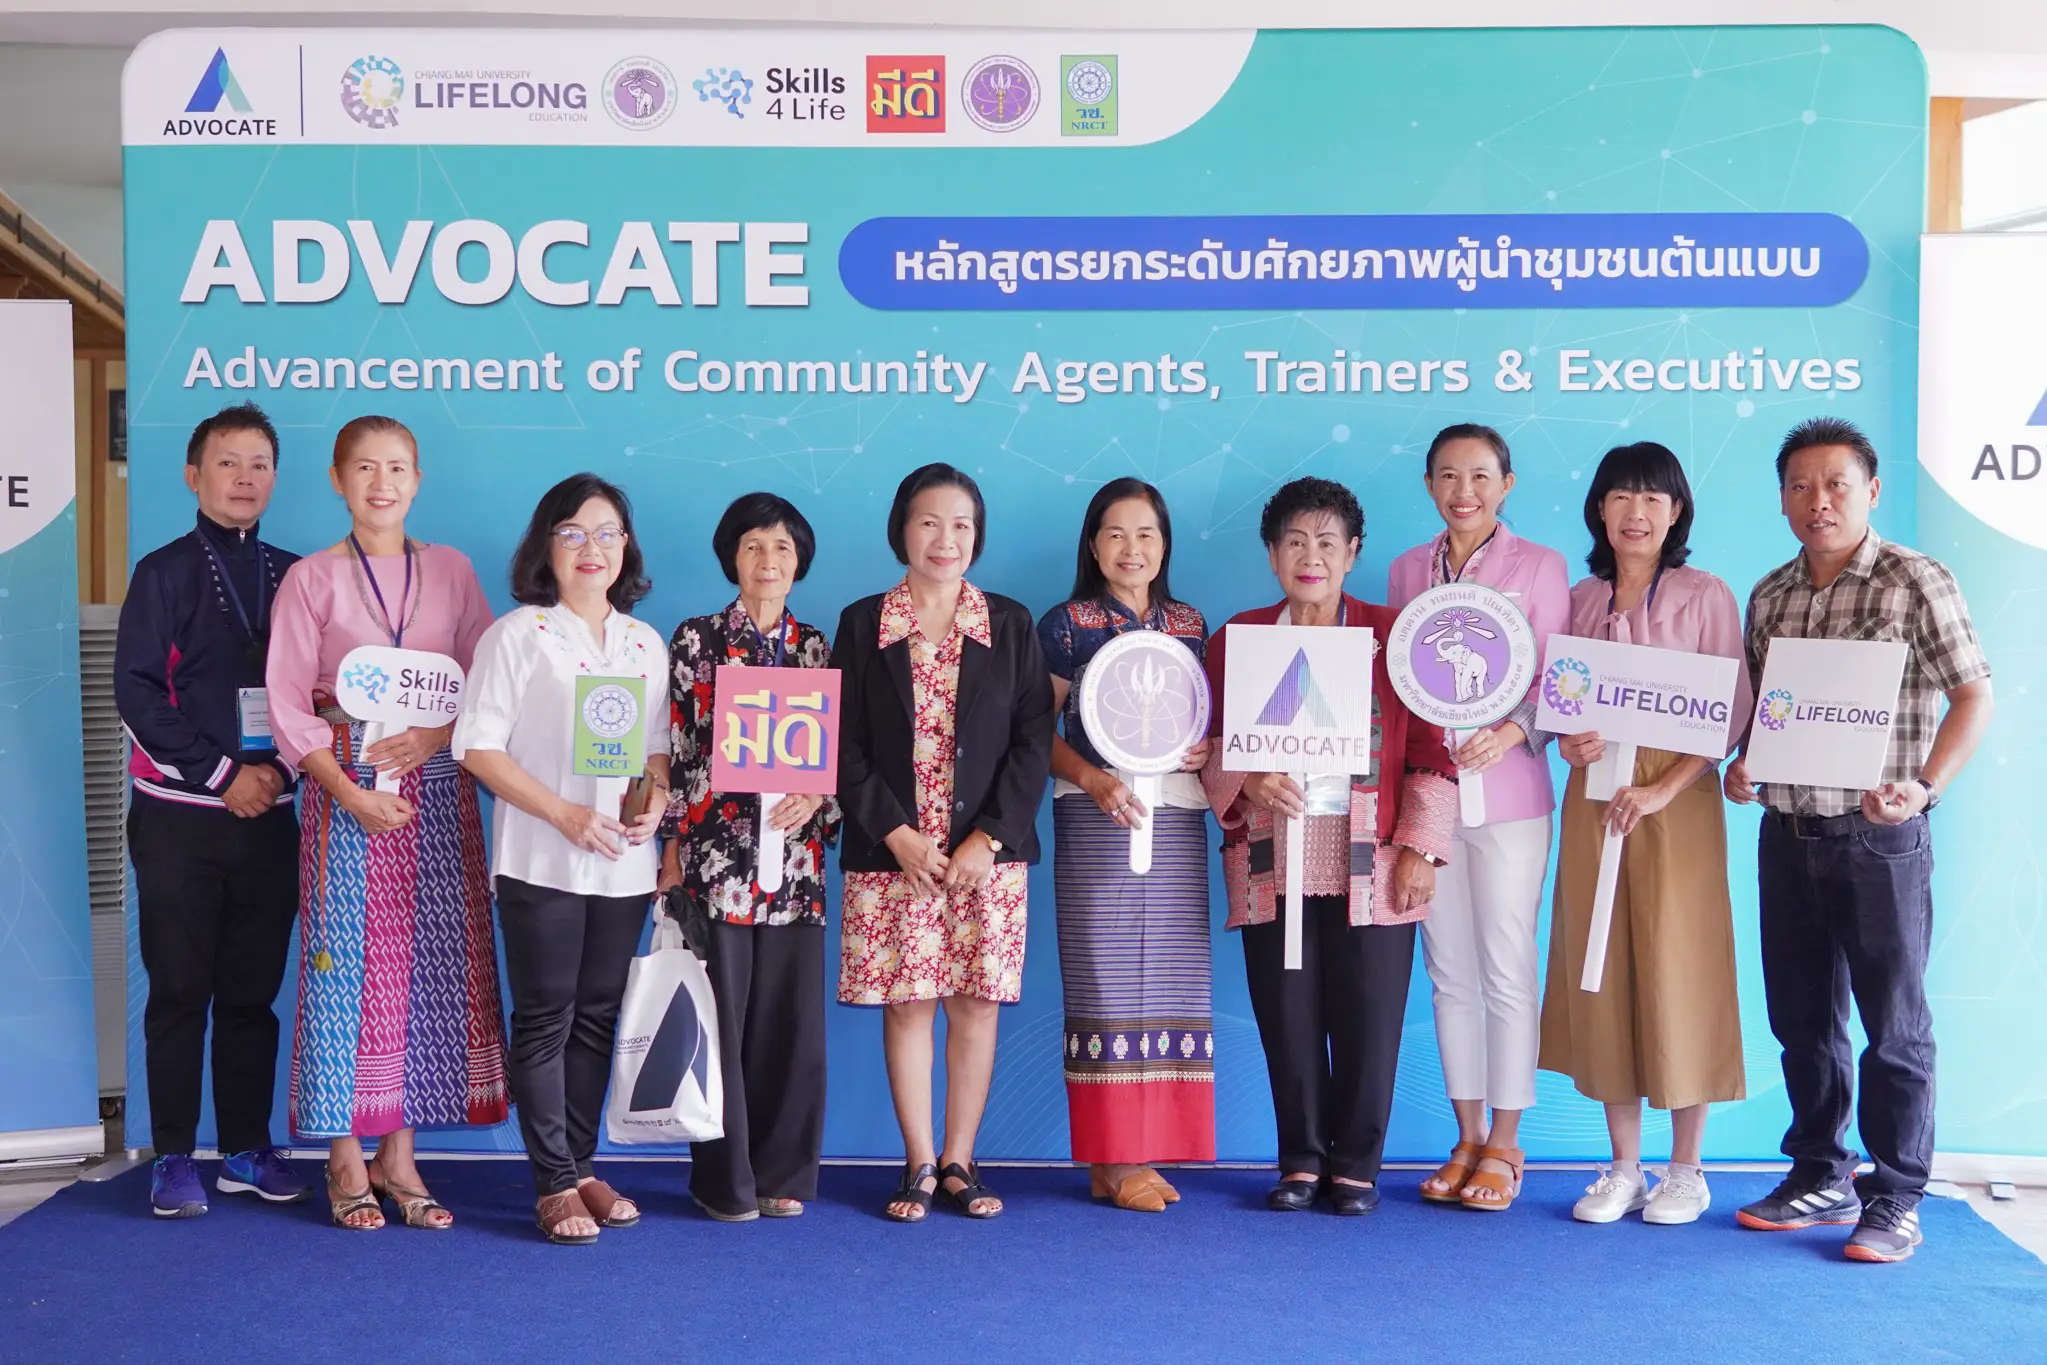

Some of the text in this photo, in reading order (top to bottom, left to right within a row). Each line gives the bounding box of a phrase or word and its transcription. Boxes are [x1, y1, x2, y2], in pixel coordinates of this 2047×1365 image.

[415, 70, 531, 79] CHIANG MAI UNIVERSITY
[766, 67, 846, 95] Skills
[415, 82, 587, 110] LIFELONG
[870, 68, 940, 119] มีดี
[529, 112, 588, 122] EDUCATION
[766, 97, 846, 121] 4 Life
[1076, 107, 1105, 119] วช.
[163, 118, 277, 136] ADVOCATE
[1071, 121, 1108, 131] NRCT
[180, 219, 811, 307] ADVOCATE
[895, 235, 1820, 294] หลักสูตรยกระดับศักยภาพผู้นำชุมชนต้นแบบ
[184, 346, 1861, 404] Advancement of Community Agents, Trainers & Executives
[1971, 444, 2047, 481] AD
[0, 475, 29, 508] E
[399, 668, 460, 694] Skills
[1600, 674, 1628, 685] CHIANG
[1646, 681, 1688, 694] UNIVERSITY
[396, 691, 457, 714] 4 Life
[1596, 683, 1728, 723] LIFELONG
[1679, 720, 1726, 734] EDUCATION
[1795, 705, 1890, 726] LIFELONG
[720, 689, 826, 769] มีดี
[592, 742, 628, 757] วช.
[1226, 733, 1365, 758] ADVOCATE
[585, 758, 631, 770] NRCT
